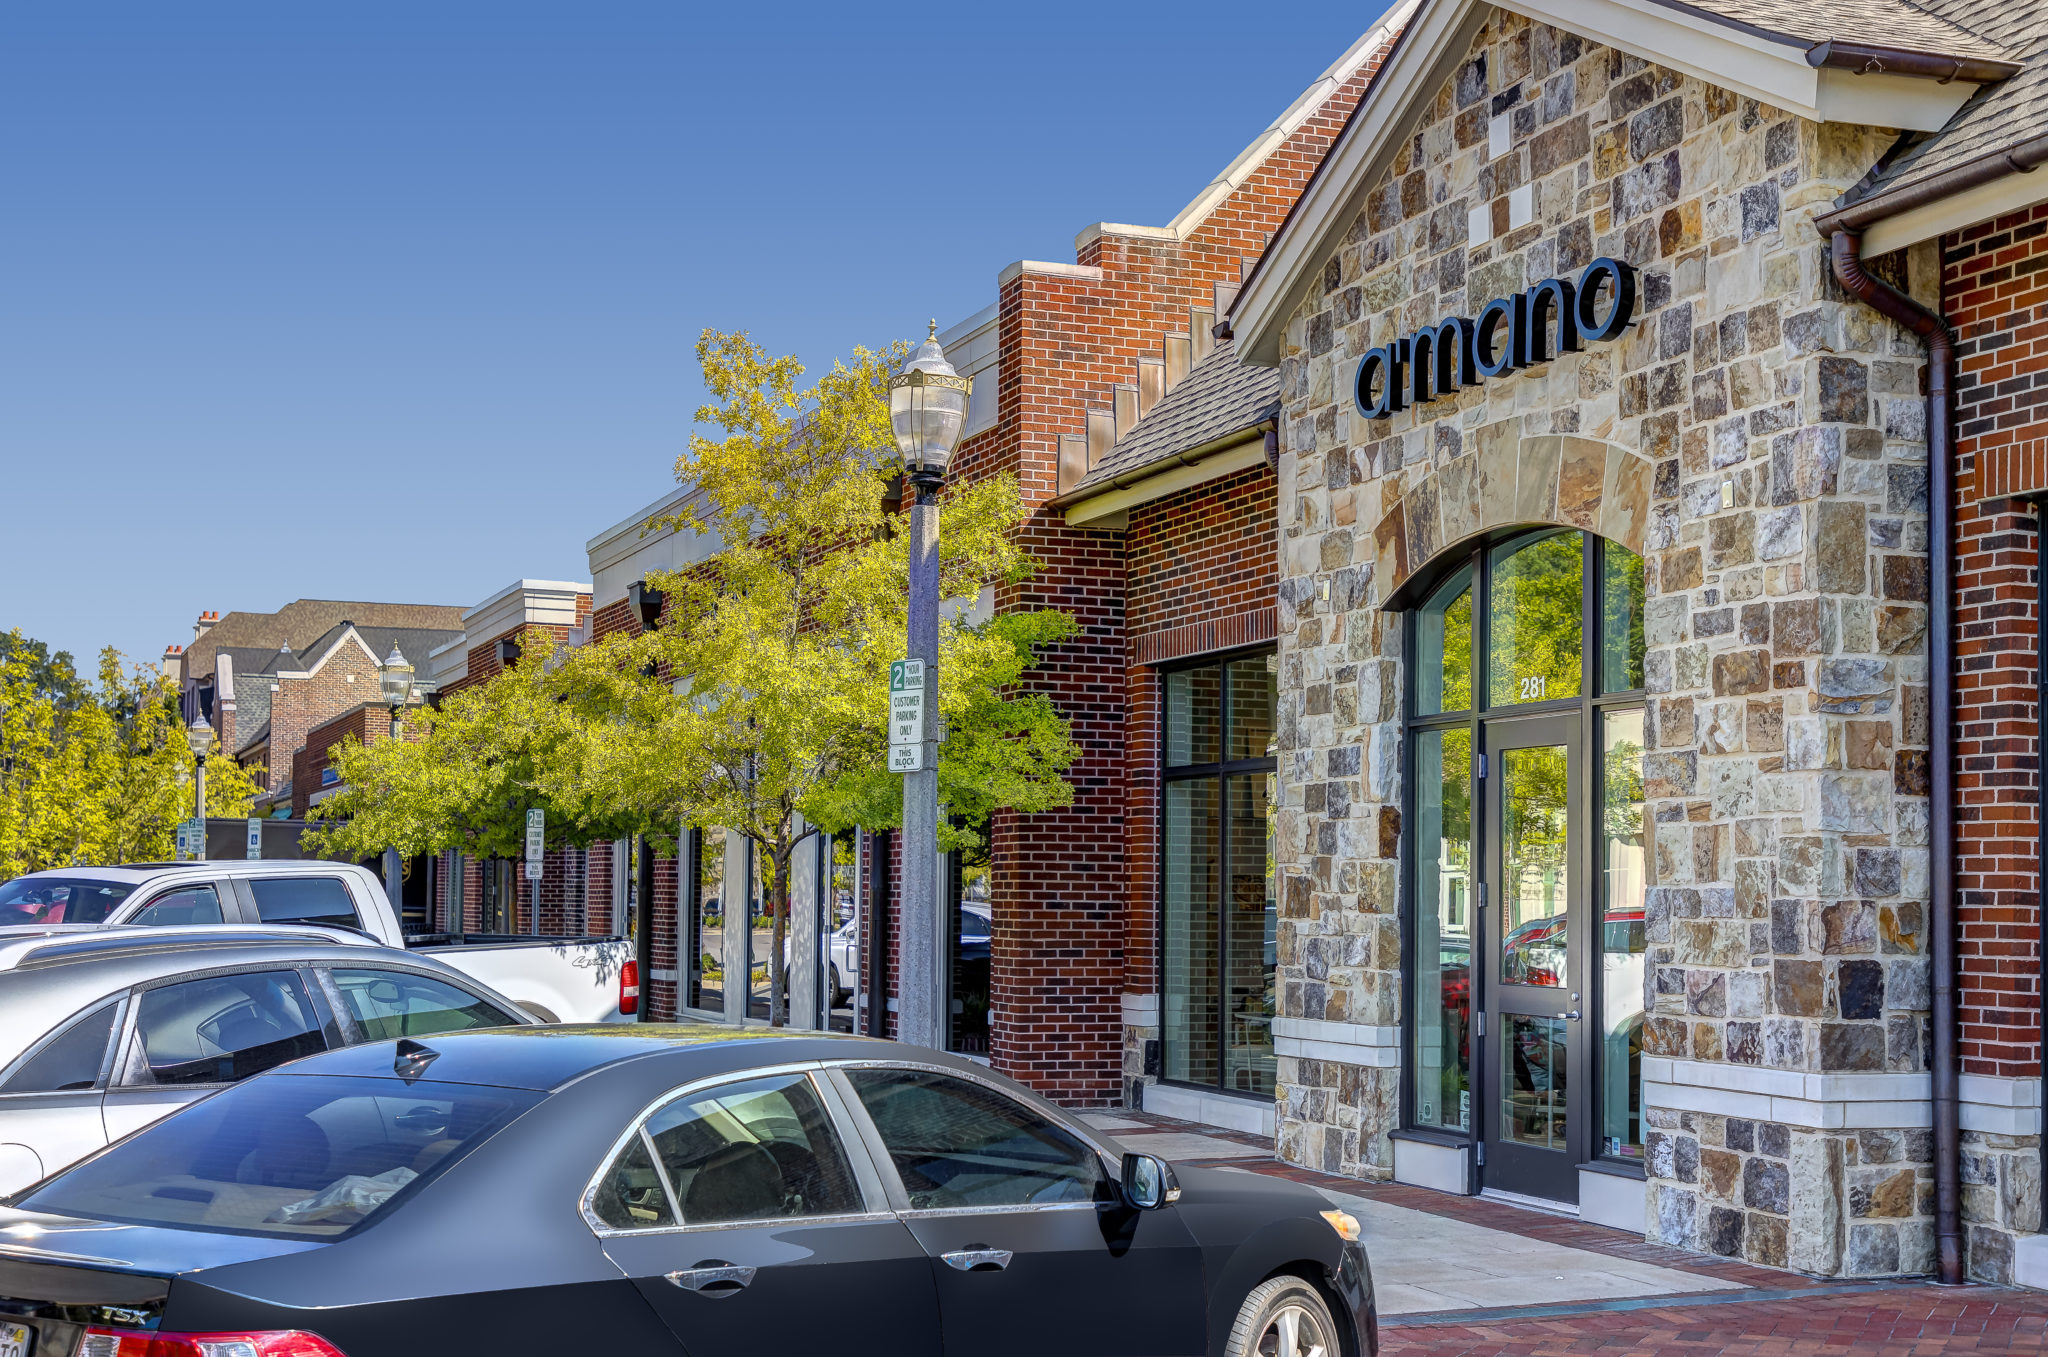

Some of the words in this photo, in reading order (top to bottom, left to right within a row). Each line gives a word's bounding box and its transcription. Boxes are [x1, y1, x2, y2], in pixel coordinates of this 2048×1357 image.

[908, 664, 920, 675] HOUR
[893, 665, 903, 689] 2
[905, 675, 922, 686] PARKING
[1520, 675, 1545, 699] 281
[893, 695, 920, 708] CUSTOMER
[895, 710, 917, 722] PARKING
[899, 724, 913, 736] ONLY
[898, 748, 912, 757] THIS
[894, 757, 915, 766] BLOCK
[528, 812, 534, 827] 2
[101, 1305, 150, 1326] TSX
